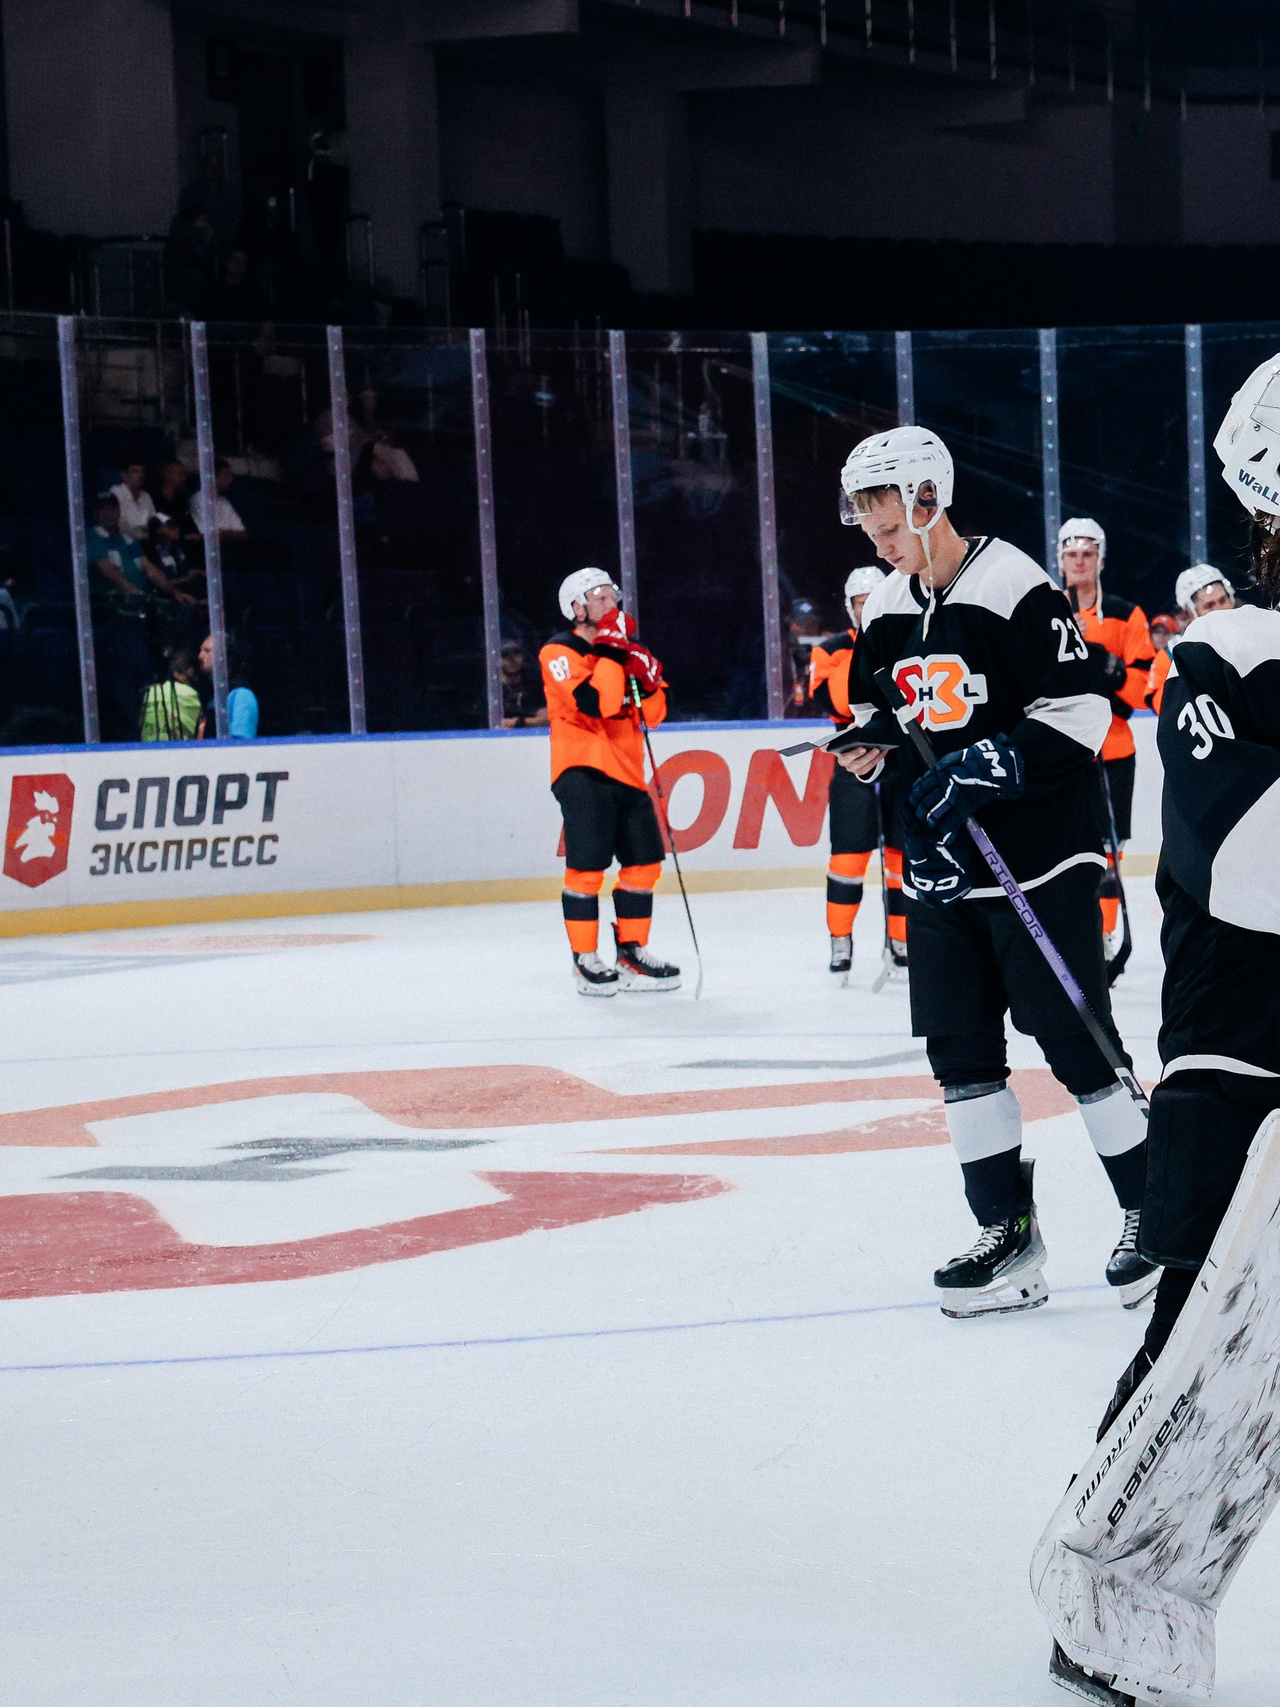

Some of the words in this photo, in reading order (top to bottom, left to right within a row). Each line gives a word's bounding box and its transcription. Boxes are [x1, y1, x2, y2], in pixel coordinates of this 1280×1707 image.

[1051, 617, 1090, 663] 23
[1177, 693, 1236, 760] 30
[94, 771, 289, 831] СПОРТ
[89, 834, 279, 876] ЭКСПРЕСС
[985, 850, 1043, 939] RIBCOR
